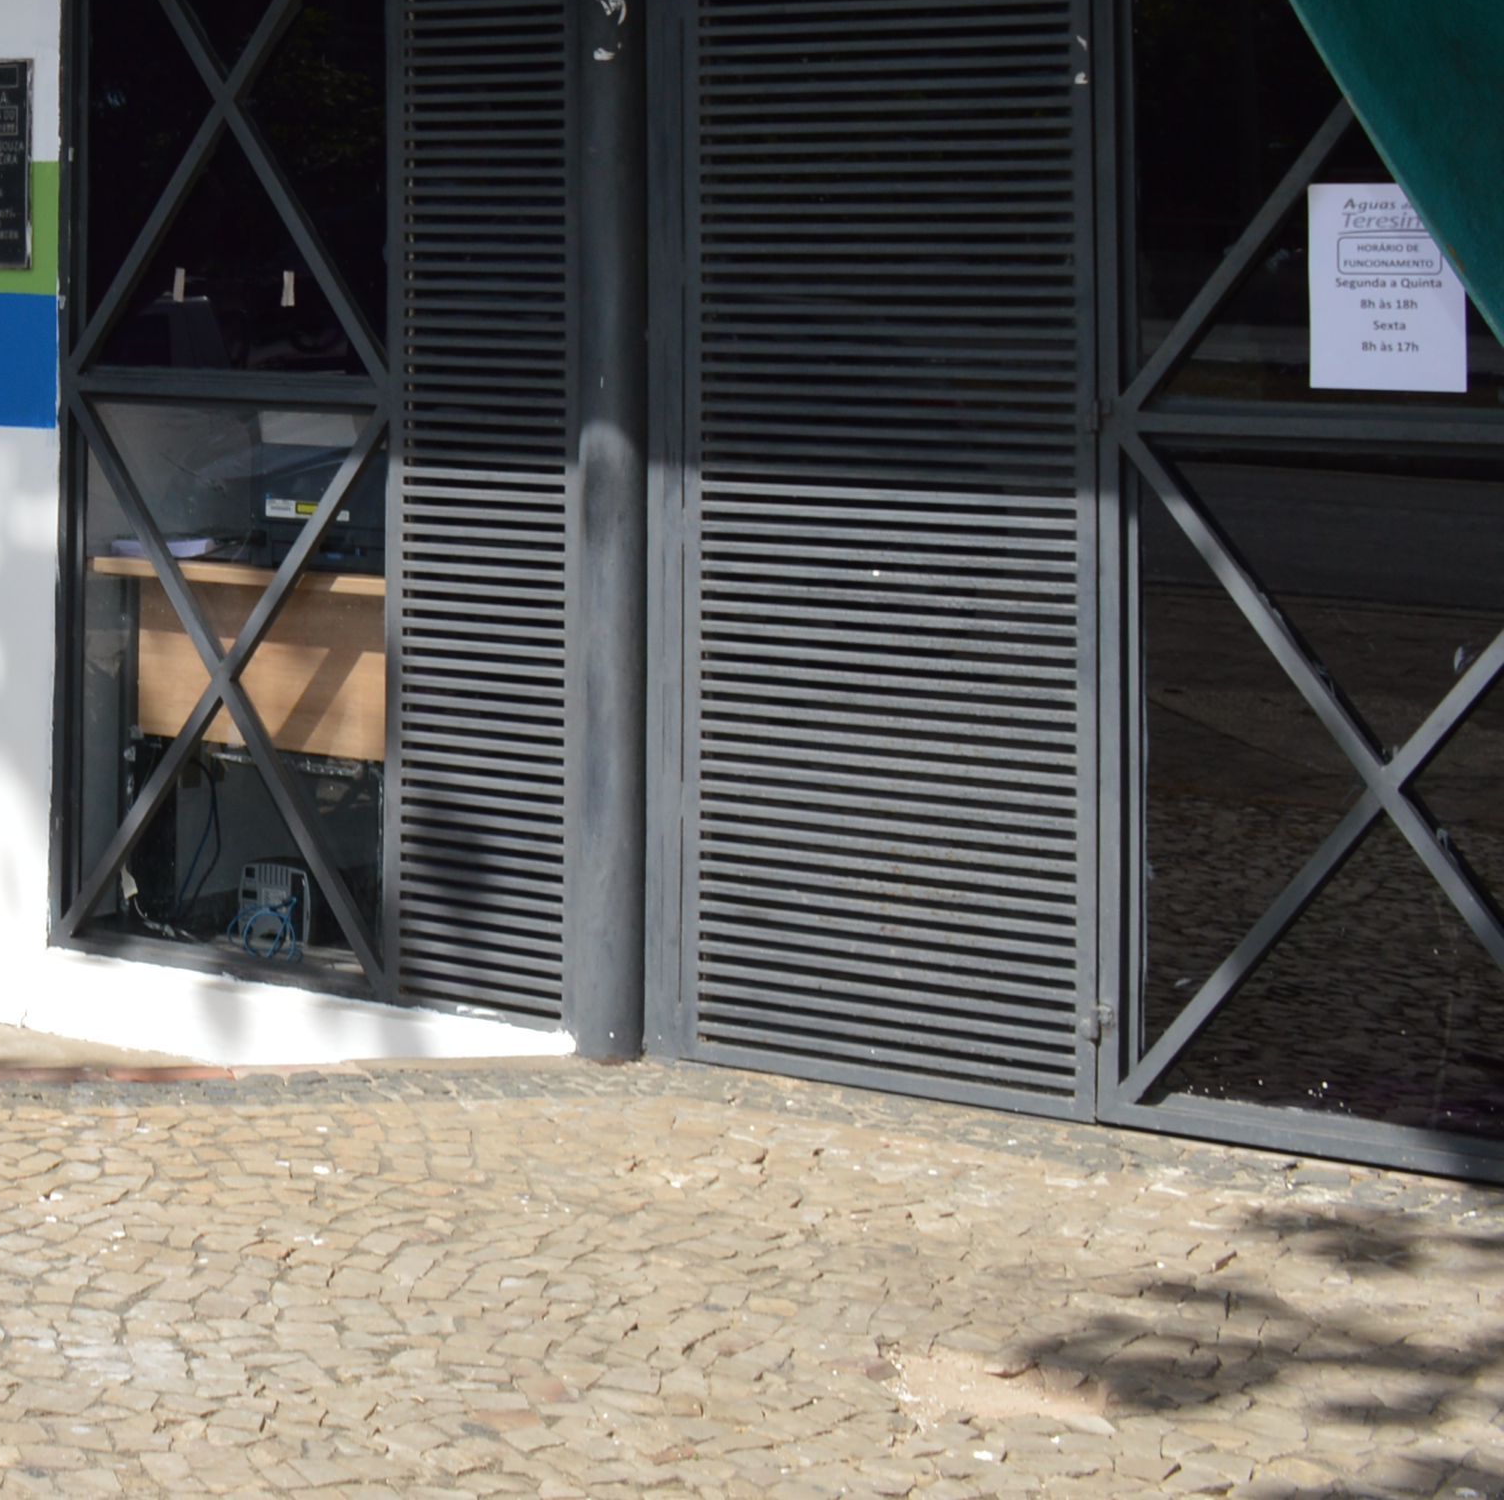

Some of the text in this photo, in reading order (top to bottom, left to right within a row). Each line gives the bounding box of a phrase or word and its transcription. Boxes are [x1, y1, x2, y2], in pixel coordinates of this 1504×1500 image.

[1341, 212, 1422, 229] Teresin
[1357, 243, 1419, 252] HORÁRIO DE
[1343, 260, 1434, 268] FUNCIONAMENTO
[1335, 278, 1386, 290] Segunda
[1400, 278, 1442, 289] Quinta
[1360, 299, 1418, 309] 8h às 18h
[1373, 320, 1406, 331] Sexta
[1361, 341, 1419, 352] 8h às 17h
